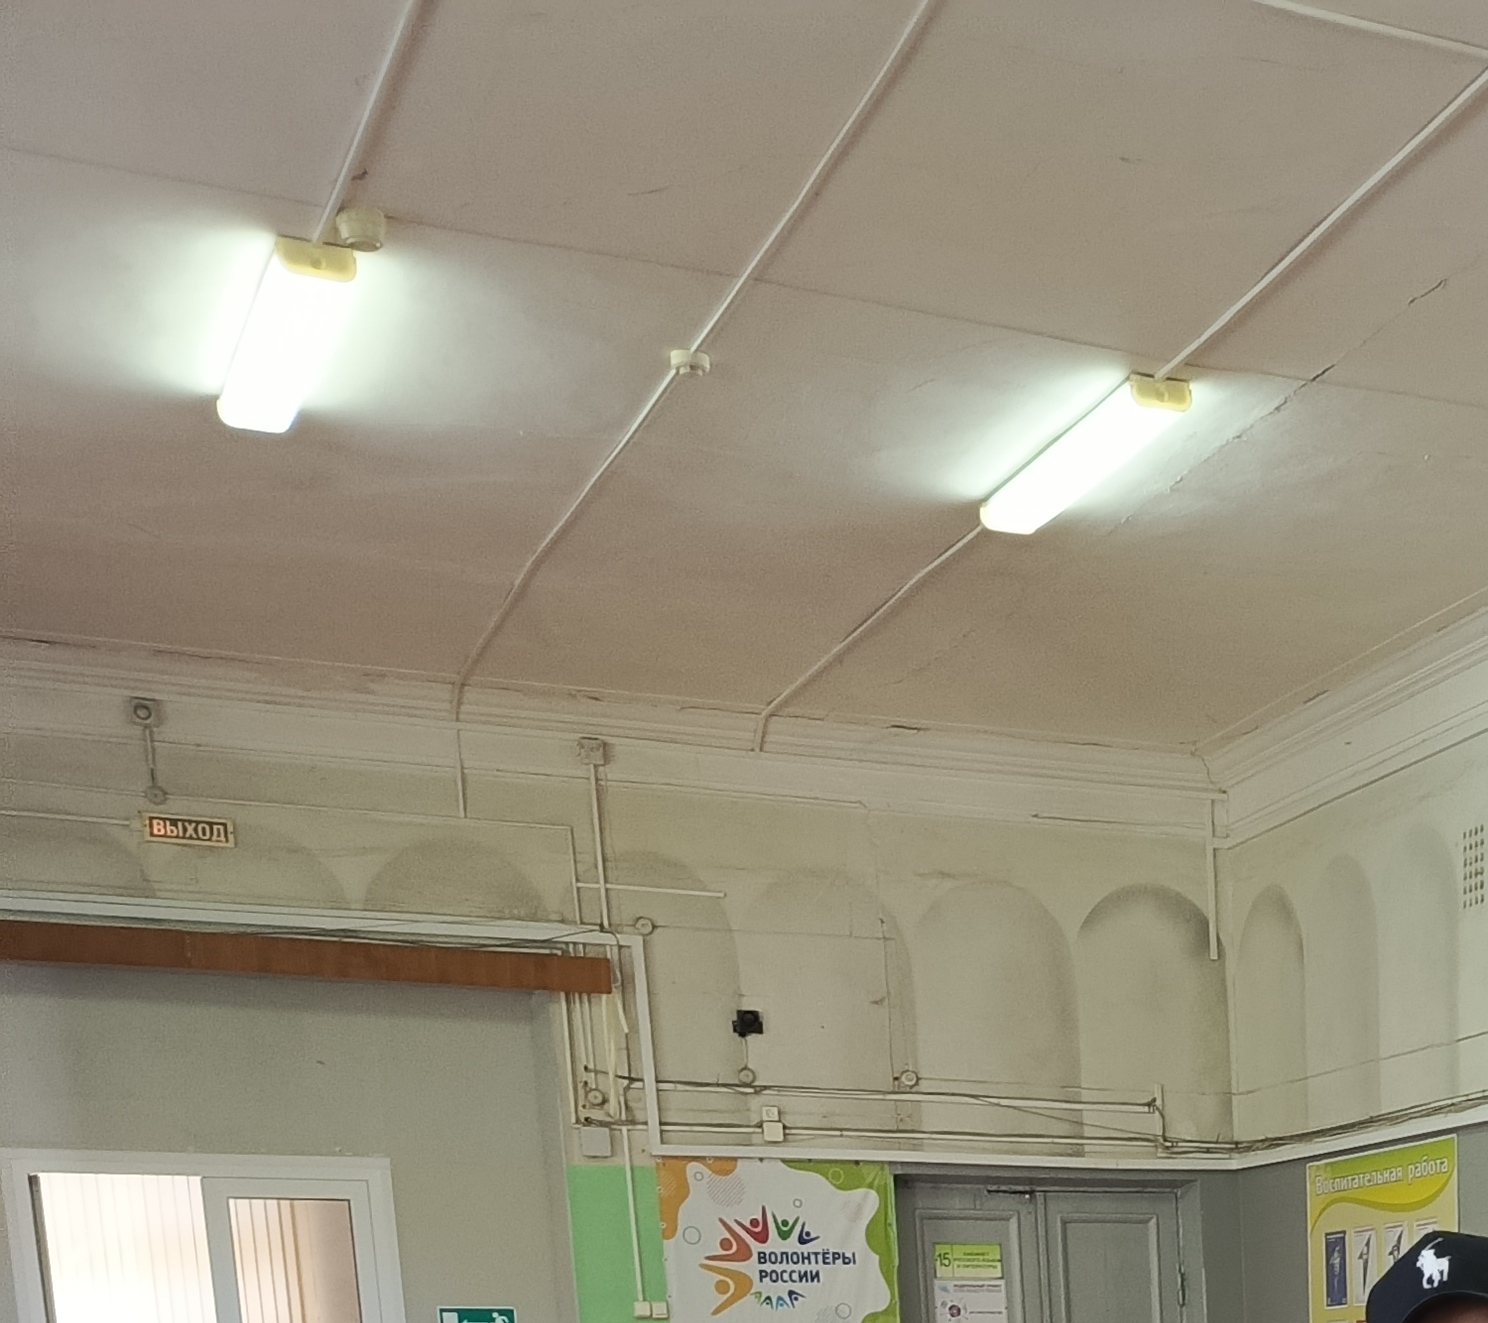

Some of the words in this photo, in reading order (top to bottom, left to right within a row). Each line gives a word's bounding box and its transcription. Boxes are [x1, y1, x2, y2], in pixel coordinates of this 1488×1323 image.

[152, 819, 226, 842] ВЫХОД
[1315, 1166, 1403, 1196] Воспитательная
[1407, 1156, 1448, 1185] работа
[757, 1249, 857, 1265] ВОЛОНТЁРЫ
[937, 1252, 951, 1267] 15
[759, 1270, 821, 1283] РОССИИ
